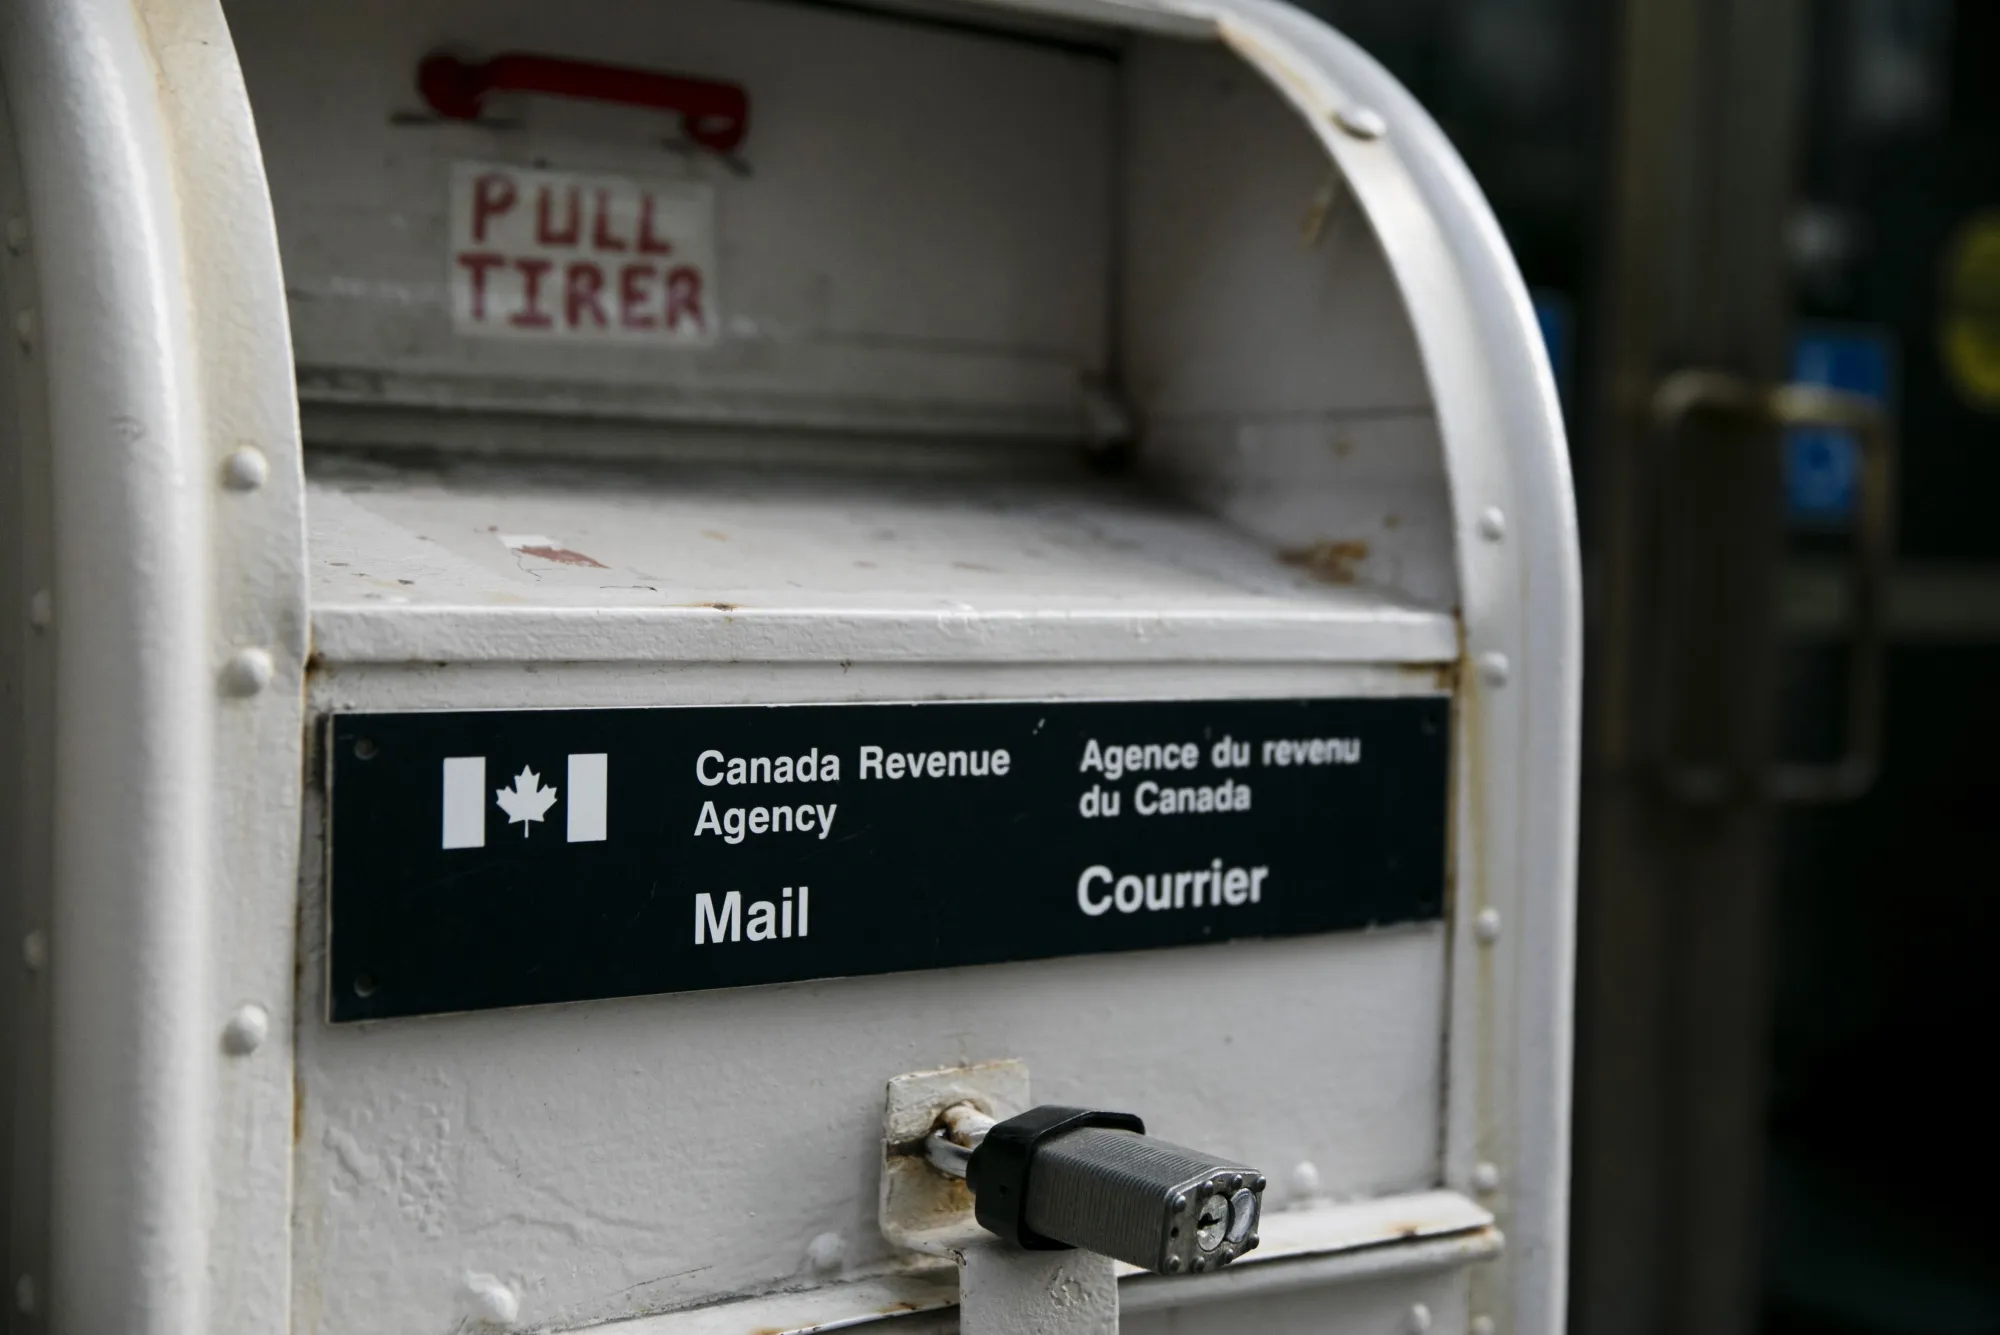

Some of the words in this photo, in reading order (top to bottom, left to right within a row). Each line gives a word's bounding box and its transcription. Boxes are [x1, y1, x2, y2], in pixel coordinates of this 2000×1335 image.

[471, 171, 673, 254] PULL
[456, 250, 706, 331] TIRER
[696, 747, 840, 787] Canada
[859, 745, 1011, 780] Revenue
[1080, 739, 1199, 780] Agence
[1212, 735, 1250, 768] du
[1263, 738, 1360, 767] revenu
[693, 800, 838, 845] Agency
[1079, 784, 1120, 818] du
[1135, 778, 1251, 816] Canada
[1077, 857, 1268, 917] Courrier
[694, 886, 809, 945] Mail
